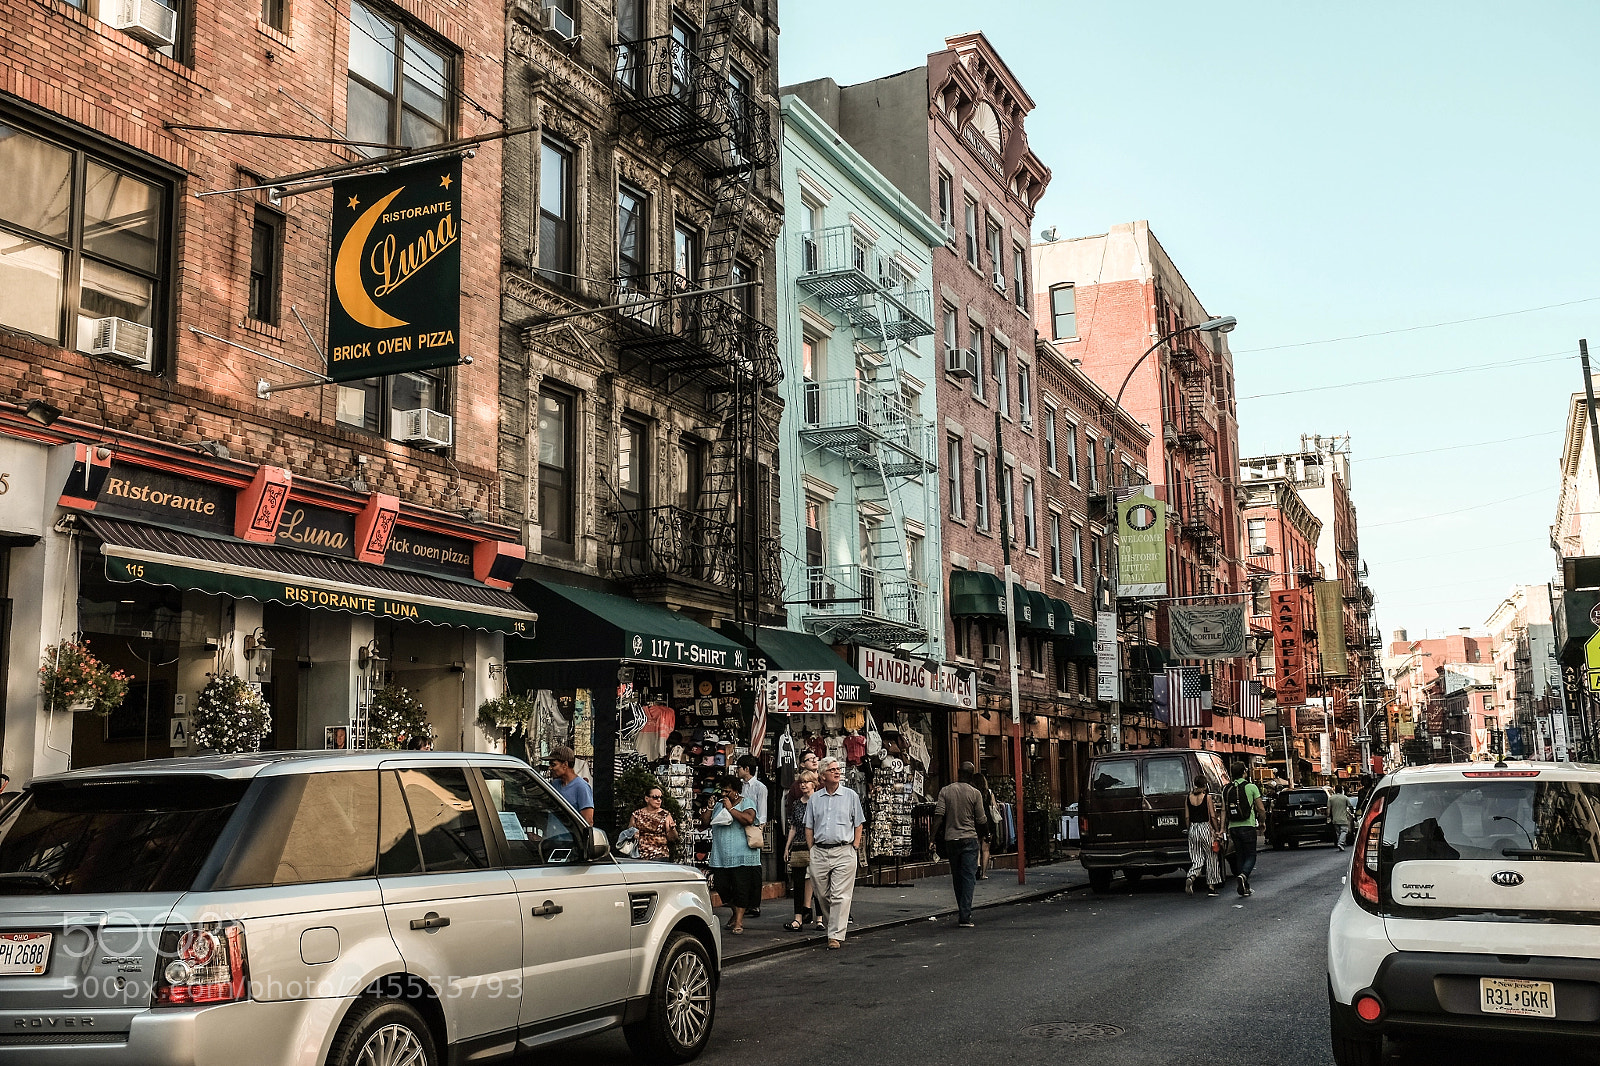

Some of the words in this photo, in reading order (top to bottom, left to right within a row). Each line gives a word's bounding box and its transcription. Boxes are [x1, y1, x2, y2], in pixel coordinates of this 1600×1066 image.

[382, 201, 452, 224] RISTORANTE
[370, 213, 457, 298] Luna
[333, 341, 371, 362] BRICK
[377, 336, 412, 355] OVEN
[418, 330, 455, 350] PIZZA
[106, 477, 216, 515] Ristorante
[279, 509, 349, 550] Luna
[1120, 534, 1163, 544] WELCOME
[413, 543, 440, 559] oven
[441, 547, 470, 566] pizza
[1121, 545, 1131, 553] TO
[1121, 553, 1161, 563] HISTORIC
[125, 563, 144, 578] 115
[1121, 563, 1151, 573] LITTLE
[1121, 573, 1146, 582] ITALY
[285, 586, 376, 612] RISTORANTE
[384, 600, 419, 618] LUNA
[513, 621, 526, 632] 115
[1192, 632, 1222, 641] CORTILE
[651, 638, 670, 660] 117
[675, 641, 727, 666] T-SHIRT
[865, 650, 925, 689] HANDBAG
[792, 673, 821, 682] HATS
[719, 680, 737, 693] FBI
[779, 682, 787, 696] 1
[803, 681, 825, 696] $4
[778, 697, 789, 711] 4
[803, 697, 834, 712] $10
[173, 721, 185, 740] A
[1496, 872, 1520, 884] KIA
[1401, 892, 1436, 900] SOUL
[14, 944, 45, 965] 2688
[101, 956, 143, 965] SPORT
[117, 965, 142, 973] HSE
[1486, 988, 1513, 1006] R31
[1521, 990, 1549, 1008] GKR
[14, 1016, 95, 1028] ROVER
